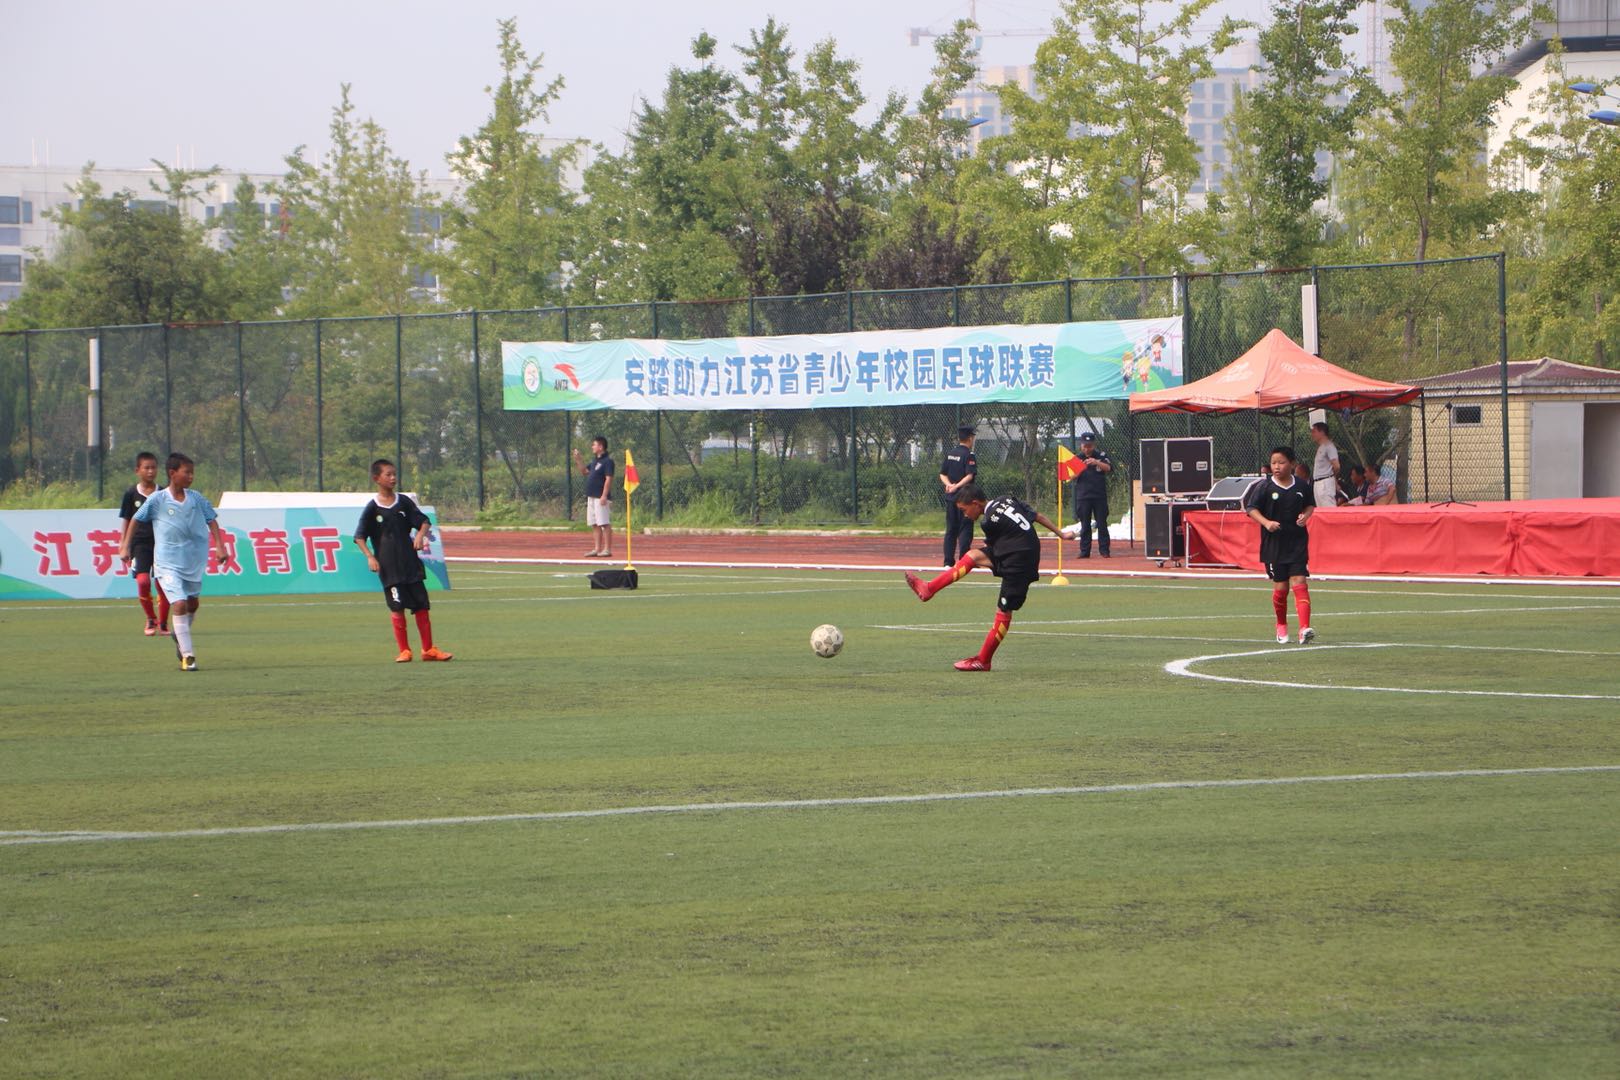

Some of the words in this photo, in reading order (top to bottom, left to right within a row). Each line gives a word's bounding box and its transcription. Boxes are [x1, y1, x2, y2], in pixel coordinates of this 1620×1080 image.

[625, 343, 1055, 397] 安踏助力江苏省青少年校园足球联赛
[1004, 506, 1031, 531] 5
[33, 528, 341, 576] 江苏教育厅
